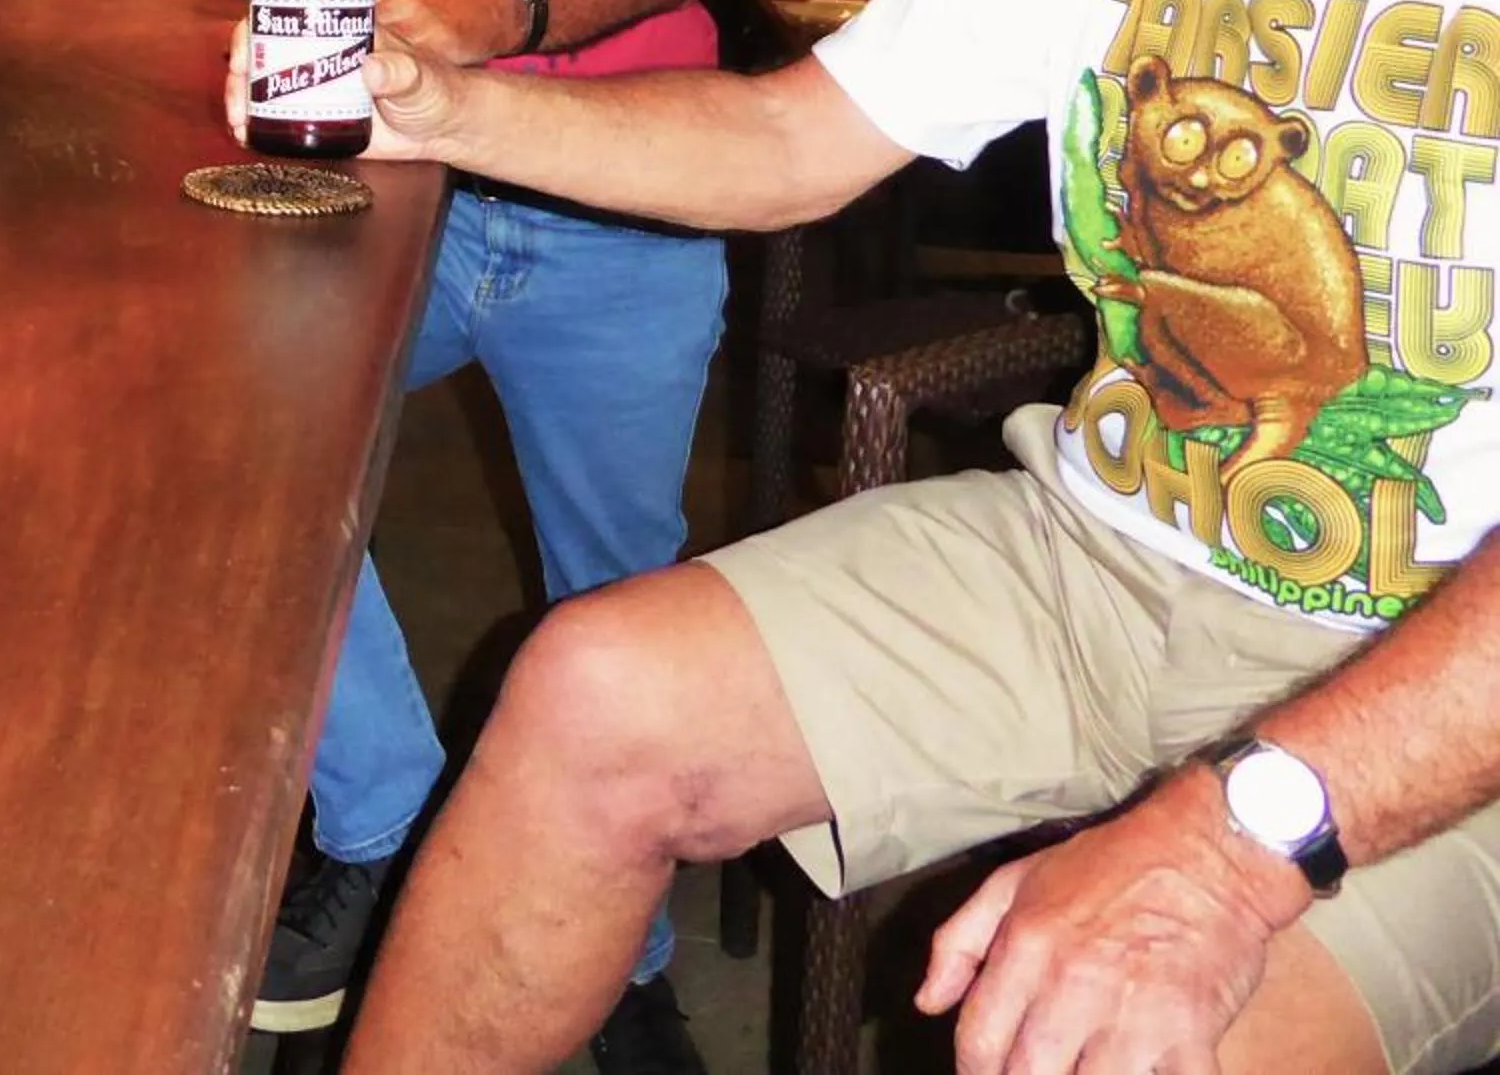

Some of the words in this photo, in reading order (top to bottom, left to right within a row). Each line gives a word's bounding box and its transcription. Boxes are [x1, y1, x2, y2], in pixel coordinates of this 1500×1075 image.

[257, 6, 299, 35] San
[301, 7, 372, 38] Miguel
[267, 67, 309, 99] Pale
[1063, 357, 1460, 597] OHOL
